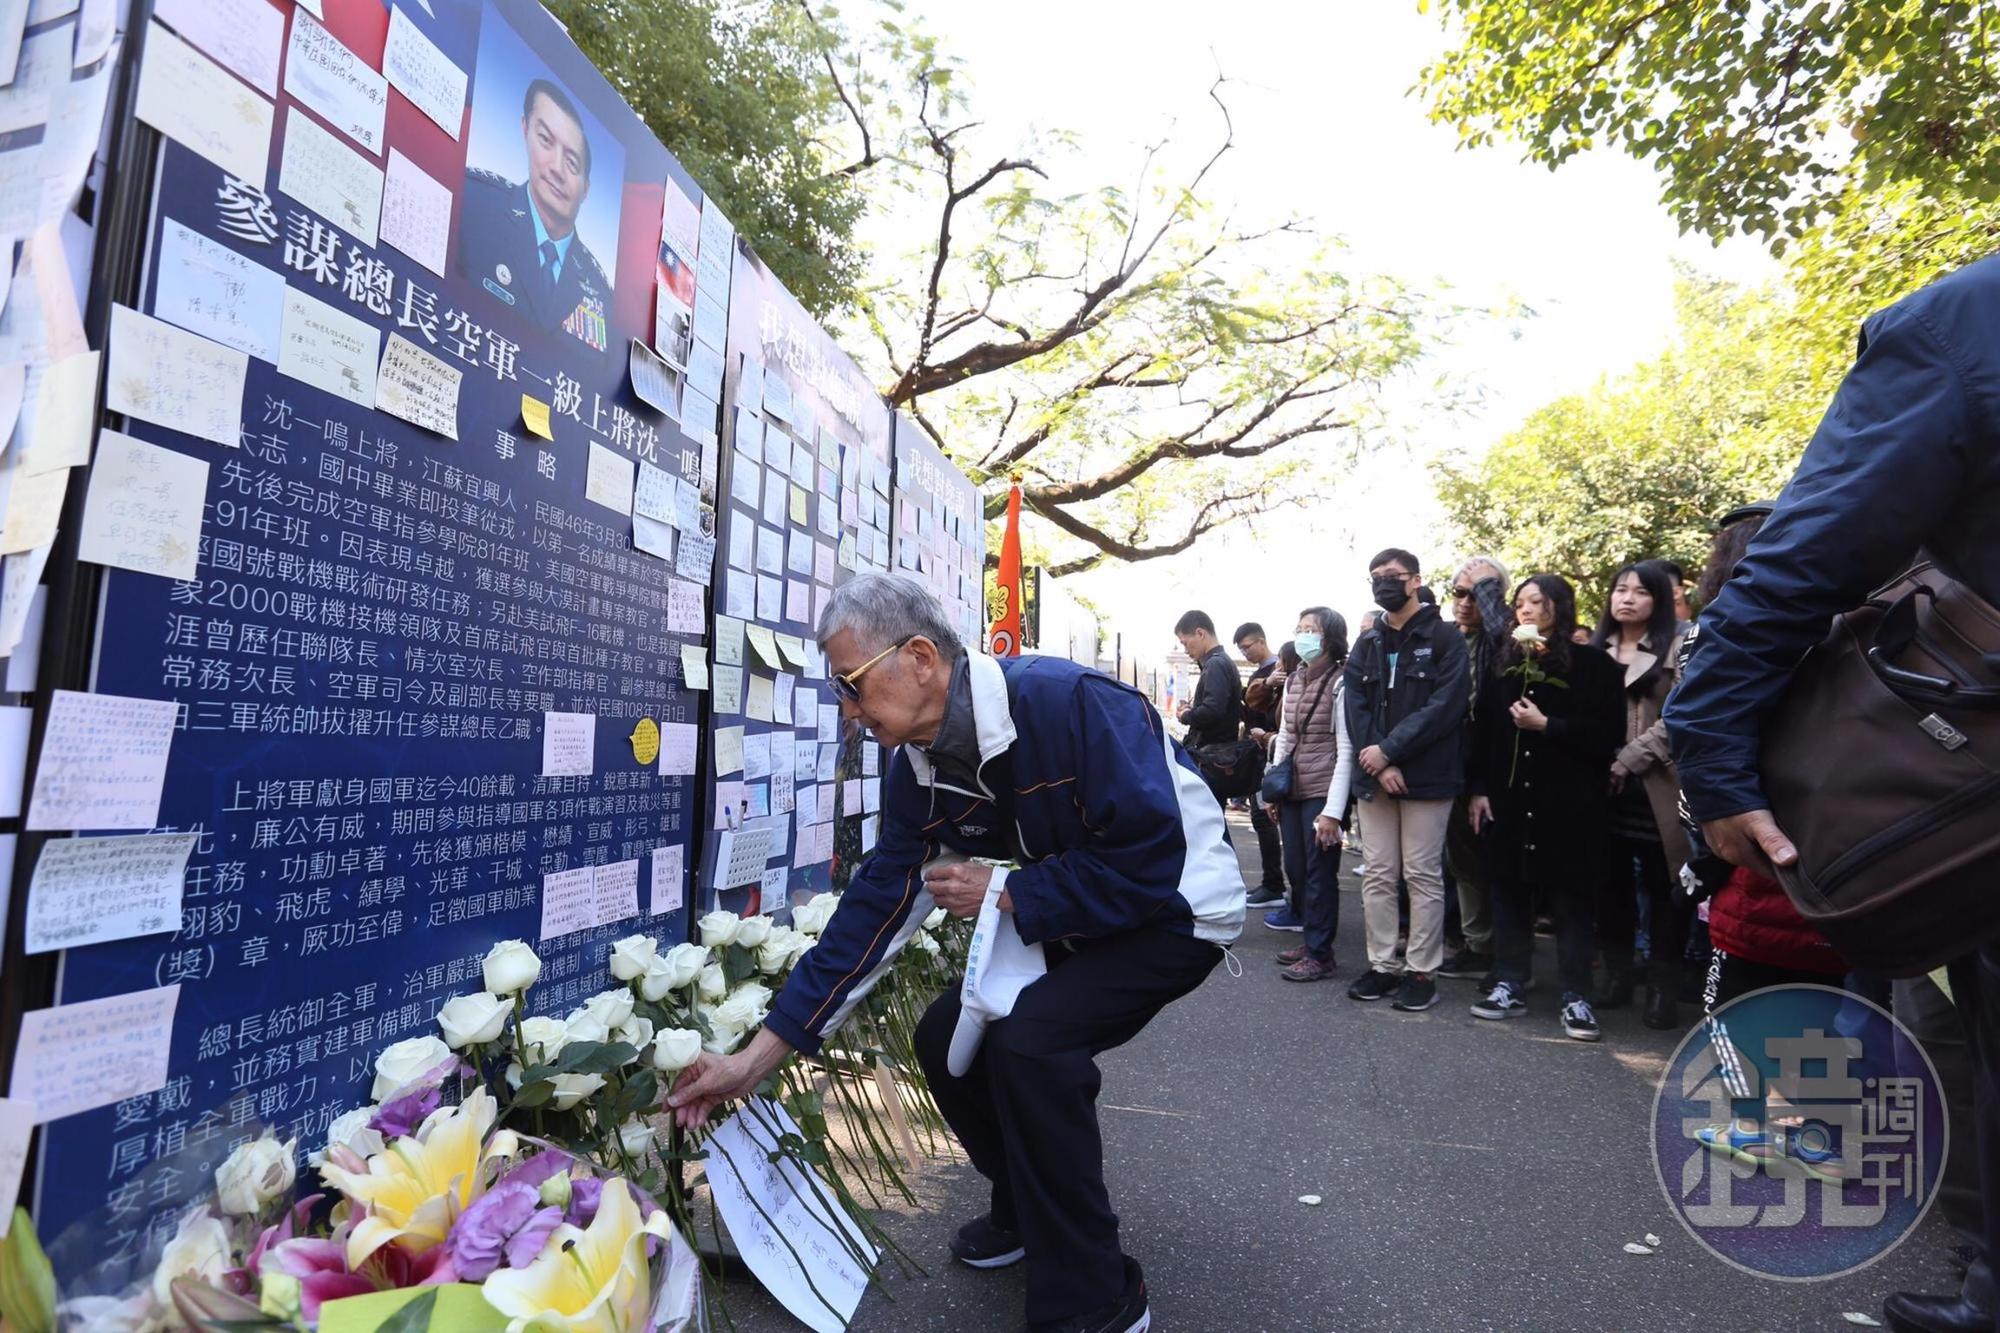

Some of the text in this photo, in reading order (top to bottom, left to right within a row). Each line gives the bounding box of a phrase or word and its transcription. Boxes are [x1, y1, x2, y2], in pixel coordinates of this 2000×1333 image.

[216, 174, 701, 487] 參謀總長空軍一級上將沈一鳴
[146, 791, 683, 856] 化，廉公有威，期間參與指導國軍各項作戰演習及救災等重
